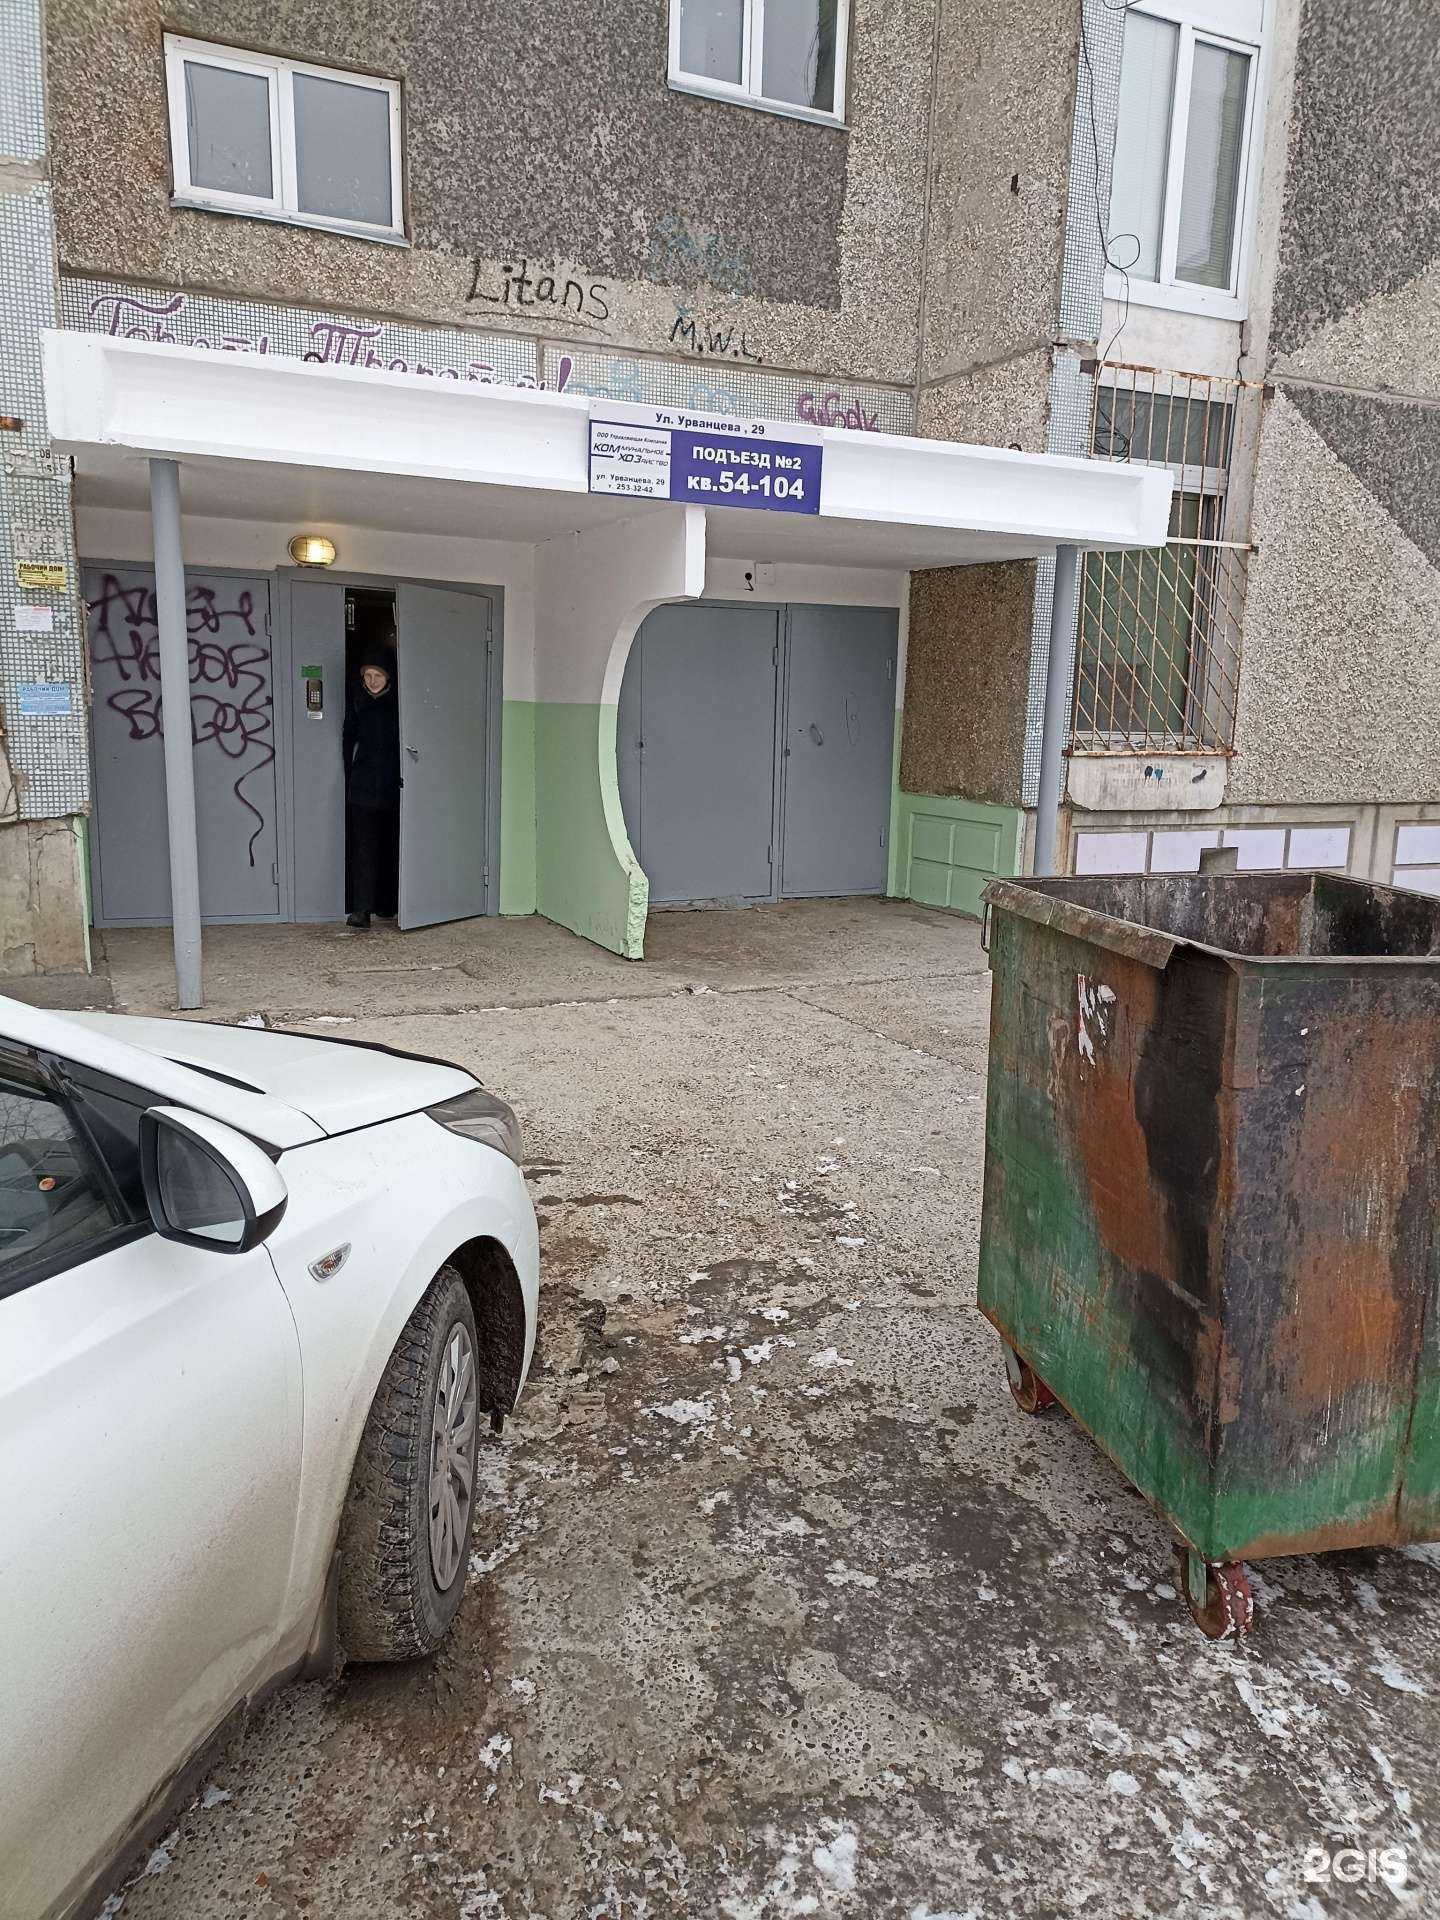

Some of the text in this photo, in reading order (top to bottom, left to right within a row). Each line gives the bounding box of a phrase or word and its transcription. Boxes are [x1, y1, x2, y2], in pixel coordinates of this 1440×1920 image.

[467, 258, 609, 322] Litans
[596, 431, 609, 439] ООО
[655, 412, 675, 425] Ул.
[678, 415, 741, 433] Урванцева
[751, 424, 765, 435] 29
[692, 445, 802, 470] ПОДЪЕЗД №2
[656, 478, 665, 486] 29
[687, 472, 805, 500] кв.54-104
